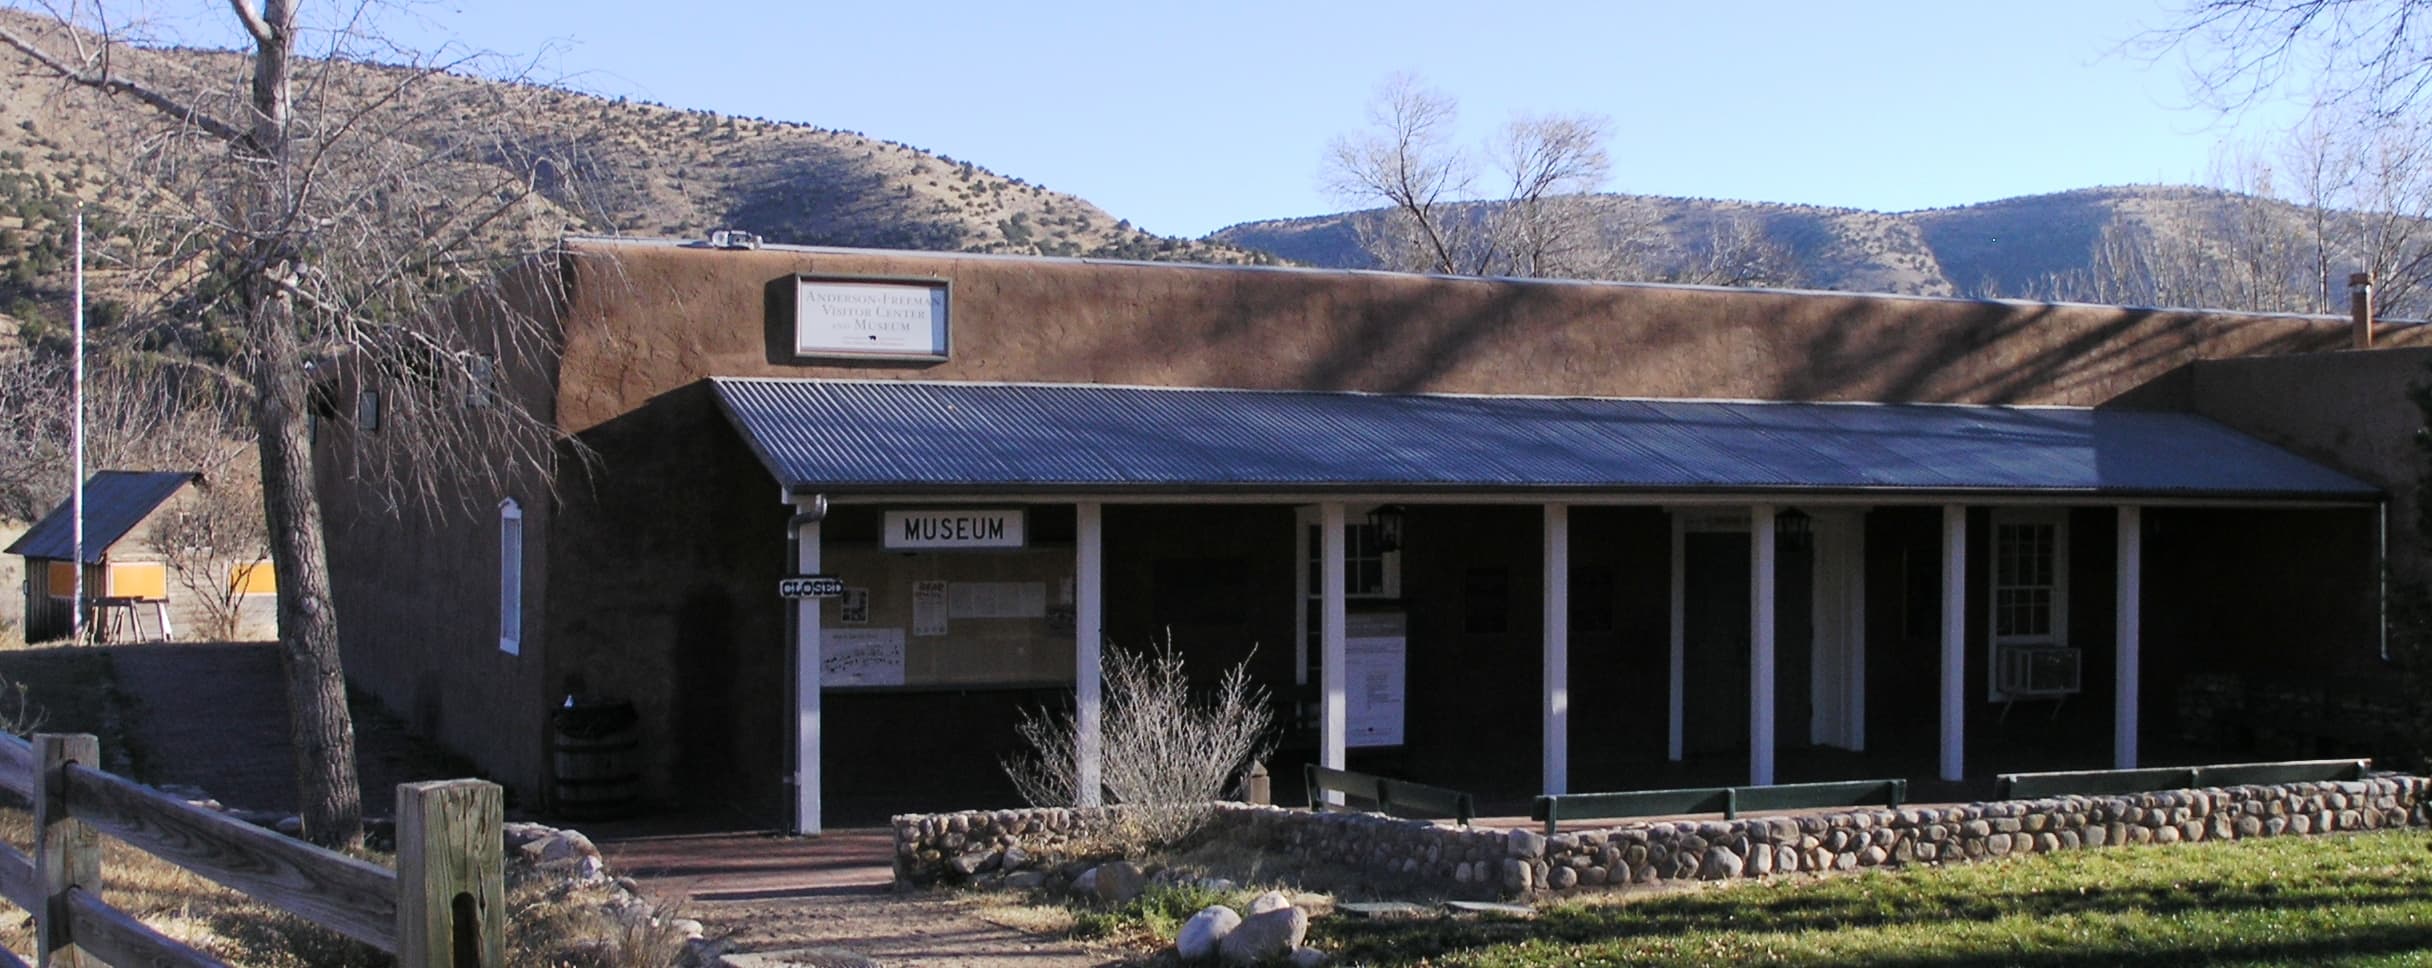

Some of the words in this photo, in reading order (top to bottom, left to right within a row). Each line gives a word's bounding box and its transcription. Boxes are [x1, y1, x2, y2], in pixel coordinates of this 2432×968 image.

[807, 291, 941, 307] ANDERSON-FREEMAN
[821, 304, 872, 318] VISITOR
[875, 305, 926, 319] CENTER
[854, 318, 912, 332] MUSEUM
[904, 517, 1005, 541] MUSEUM
[781, 580, 844, 596] CLOSED
